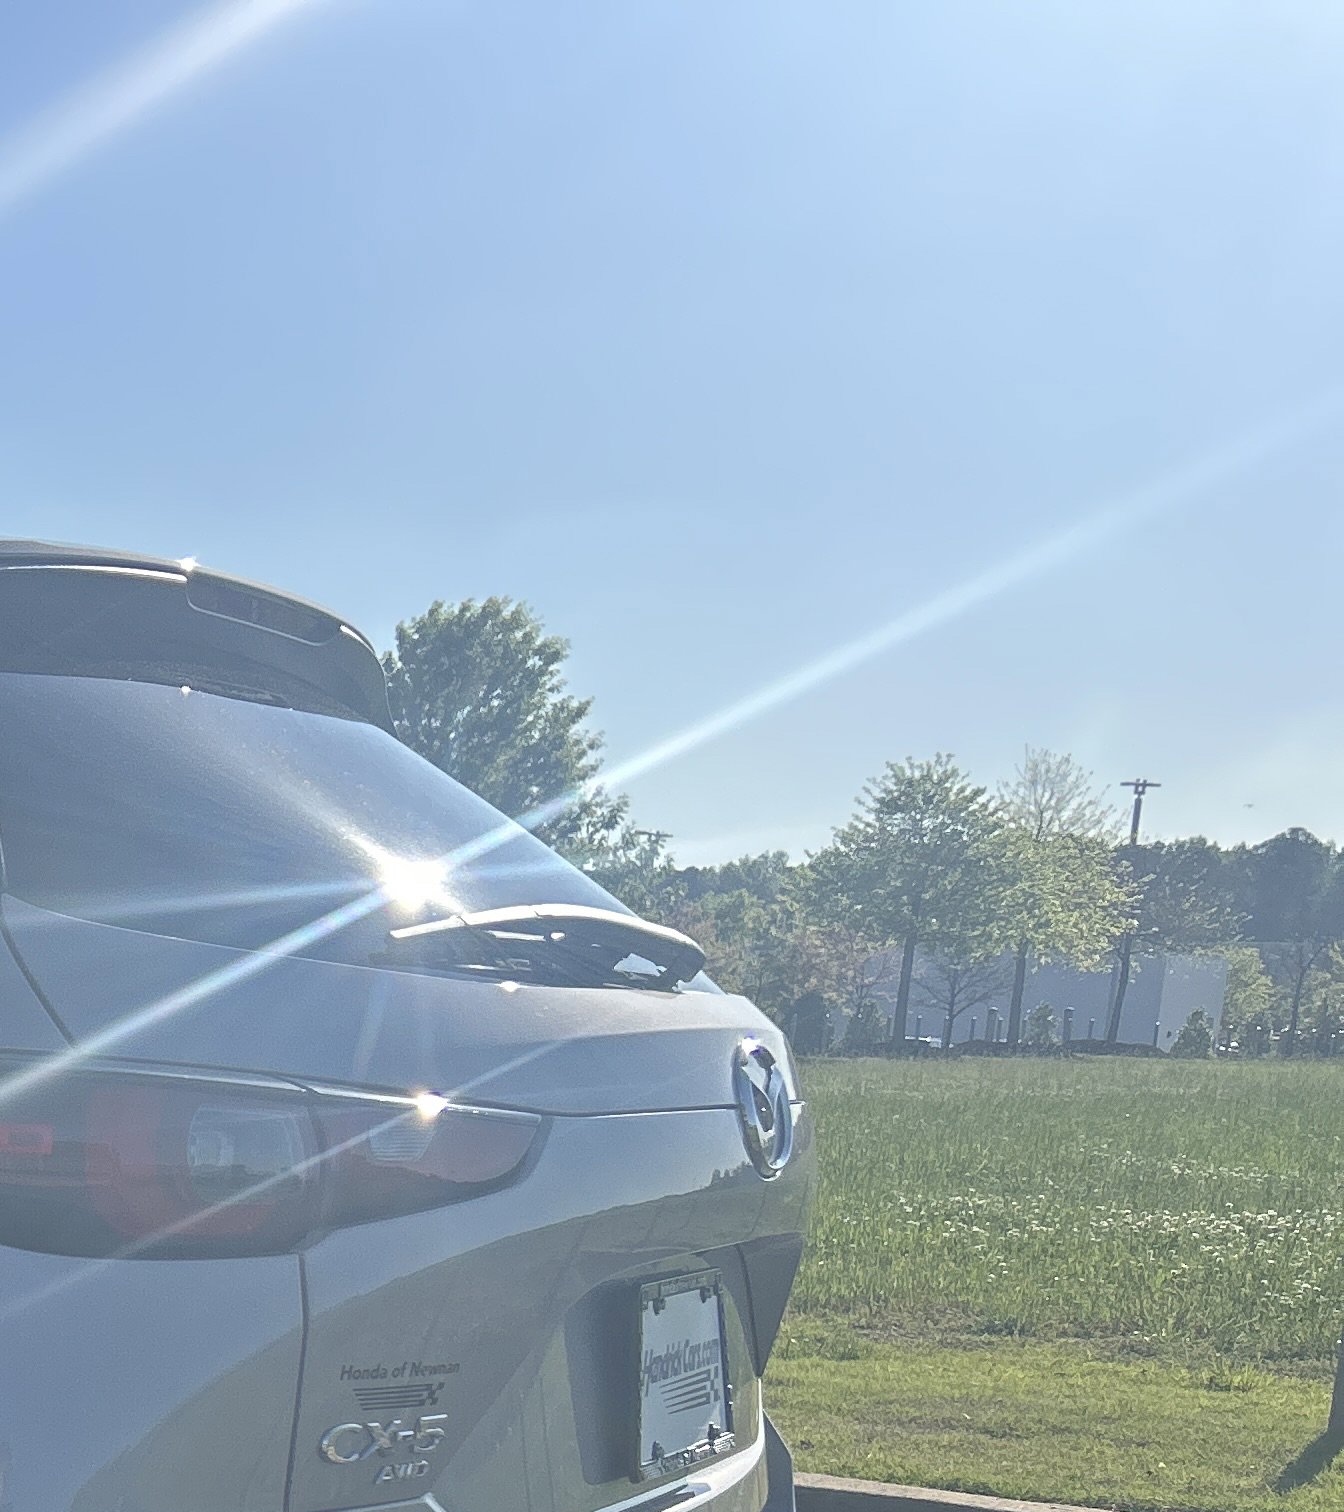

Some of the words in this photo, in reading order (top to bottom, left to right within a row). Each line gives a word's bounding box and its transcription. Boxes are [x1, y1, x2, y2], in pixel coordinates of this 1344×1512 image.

[340, 1363, 389, 1381] Honda
[392, 1361, 408, 1378] of
[319, 1413, 448, 1463] CX-5
[375, 1460, 429, 1485] AWD
